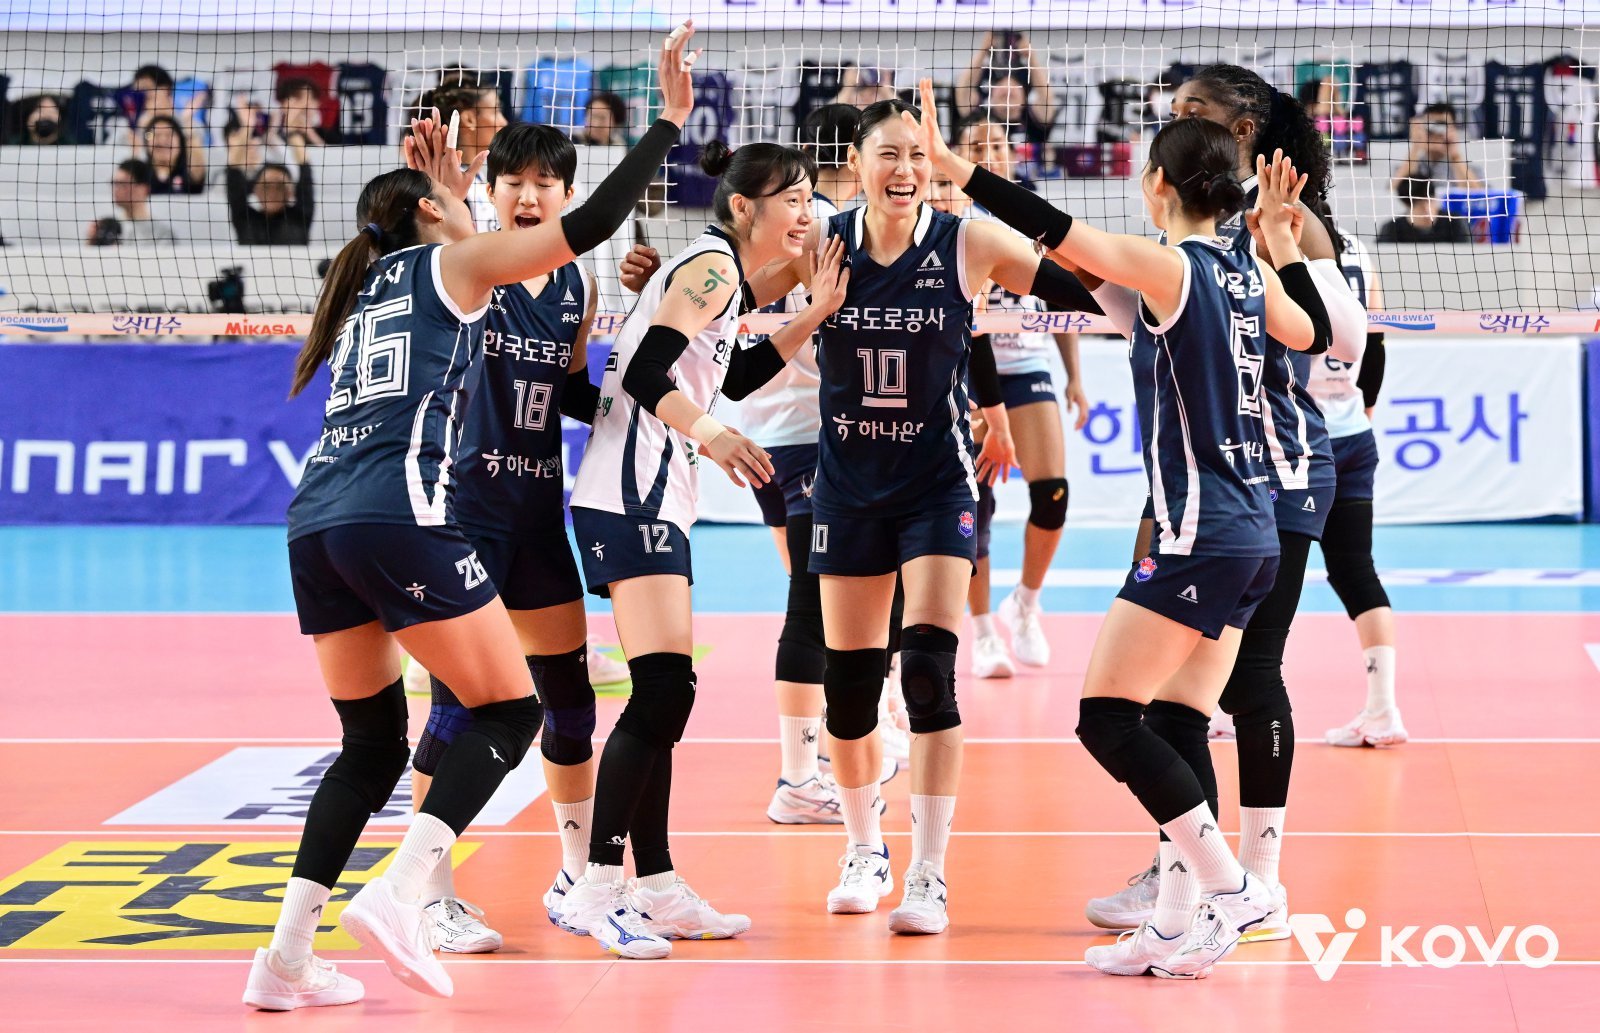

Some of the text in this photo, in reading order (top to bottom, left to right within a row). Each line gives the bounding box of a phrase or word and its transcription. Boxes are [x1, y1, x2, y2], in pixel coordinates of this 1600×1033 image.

[37, 316, 68, 324] SWEAT
[1403, 314, 1434, 322] SWEAT
[857, 348, 907, 395] 10
[513, 379, 553, 432] 18
[638, 523, 673, 554] 12
[454, 550, 489, 591] 26
